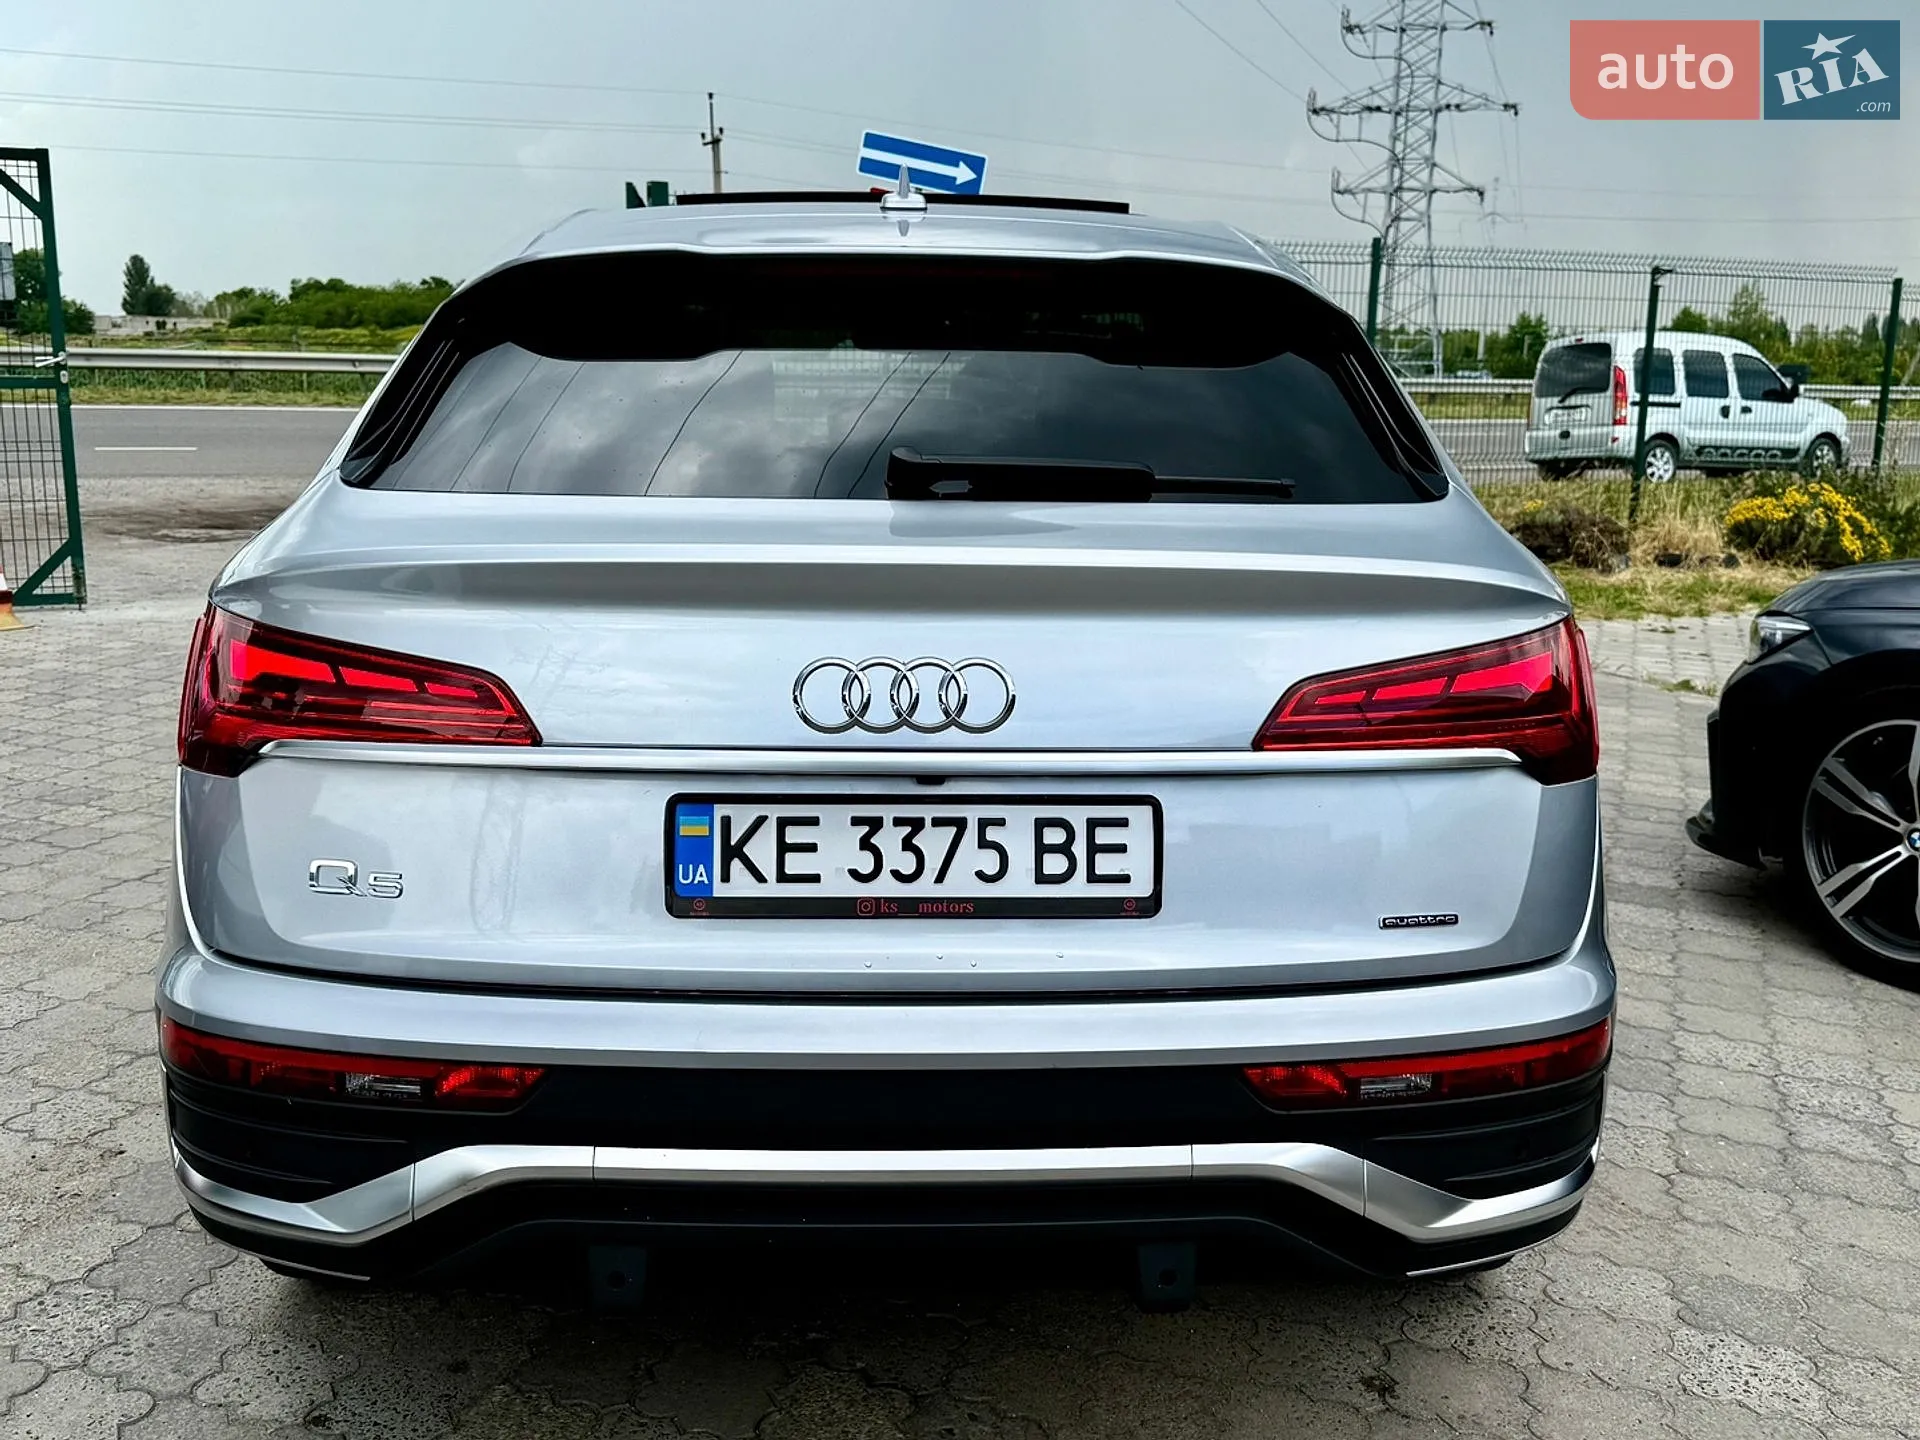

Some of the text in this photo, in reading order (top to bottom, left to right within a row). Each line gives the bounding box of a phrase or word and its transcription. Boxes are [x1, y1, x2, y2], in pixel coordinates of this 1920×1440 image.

[720, 815, 1133, 885] KE 3375 BE
[308, 858, 404, 899] Q5
[678, 863, 710, 885] UA
[1384, 915, 1456, 926] quattro
